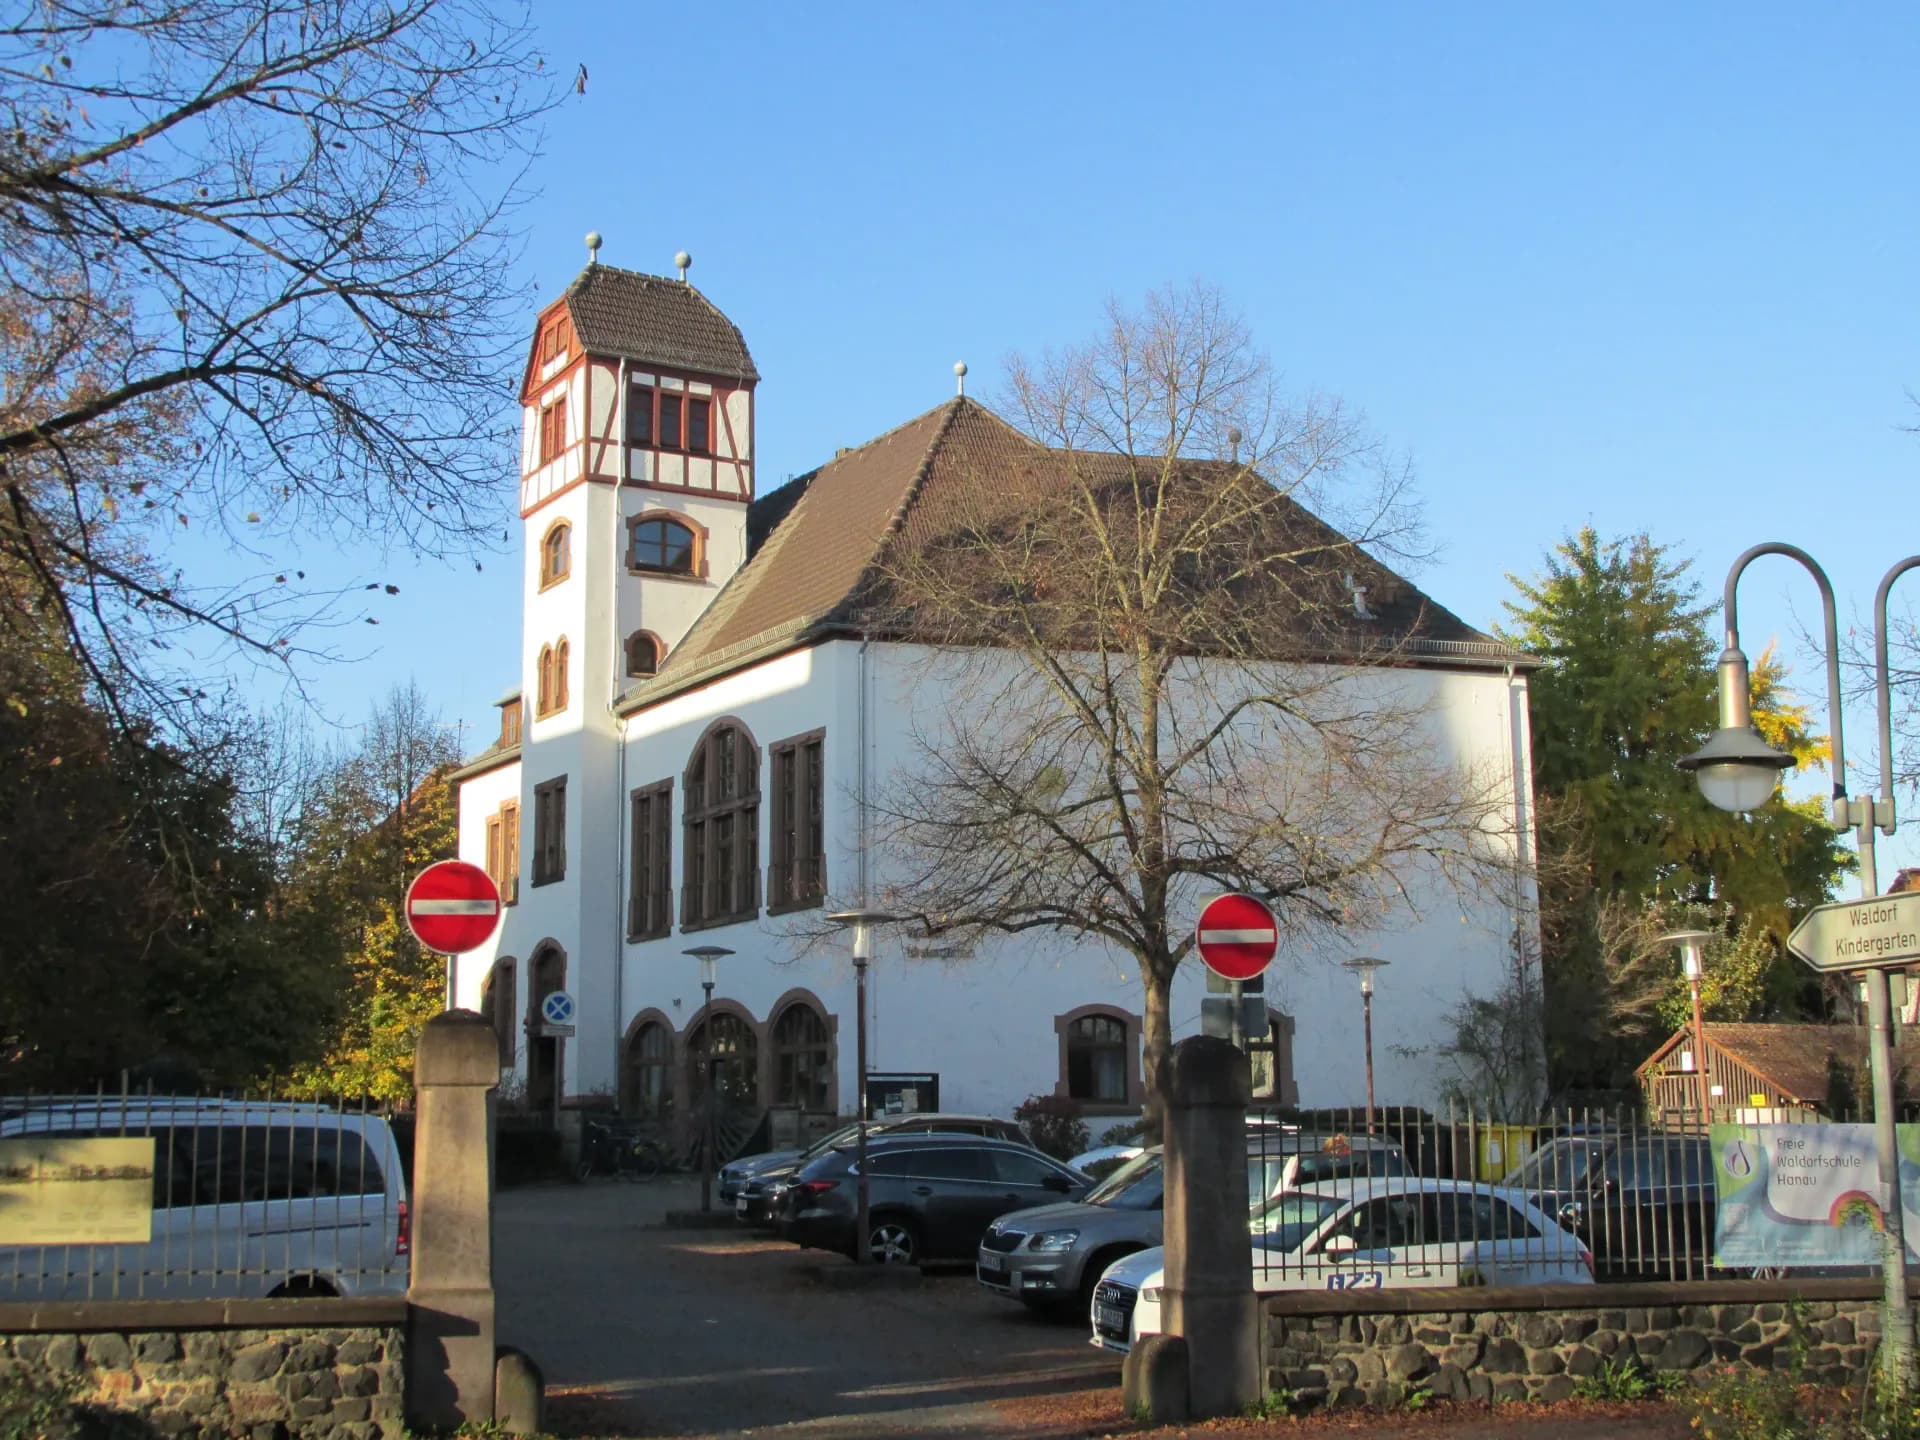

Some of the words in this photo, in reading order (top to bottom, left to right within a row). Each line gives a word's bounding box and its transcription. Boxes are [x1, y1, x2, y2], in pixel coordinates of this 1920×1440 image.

[1850, 904, 1898, 926] Waldorf
[1836, 932, 1916, 956] Kindergarten
[1777, 1138, 1805, 1150] Freie
[1777, 1155, 1861, 1168] Waldorfschule
[1777, 1174, 1817, 1185] Hanau
